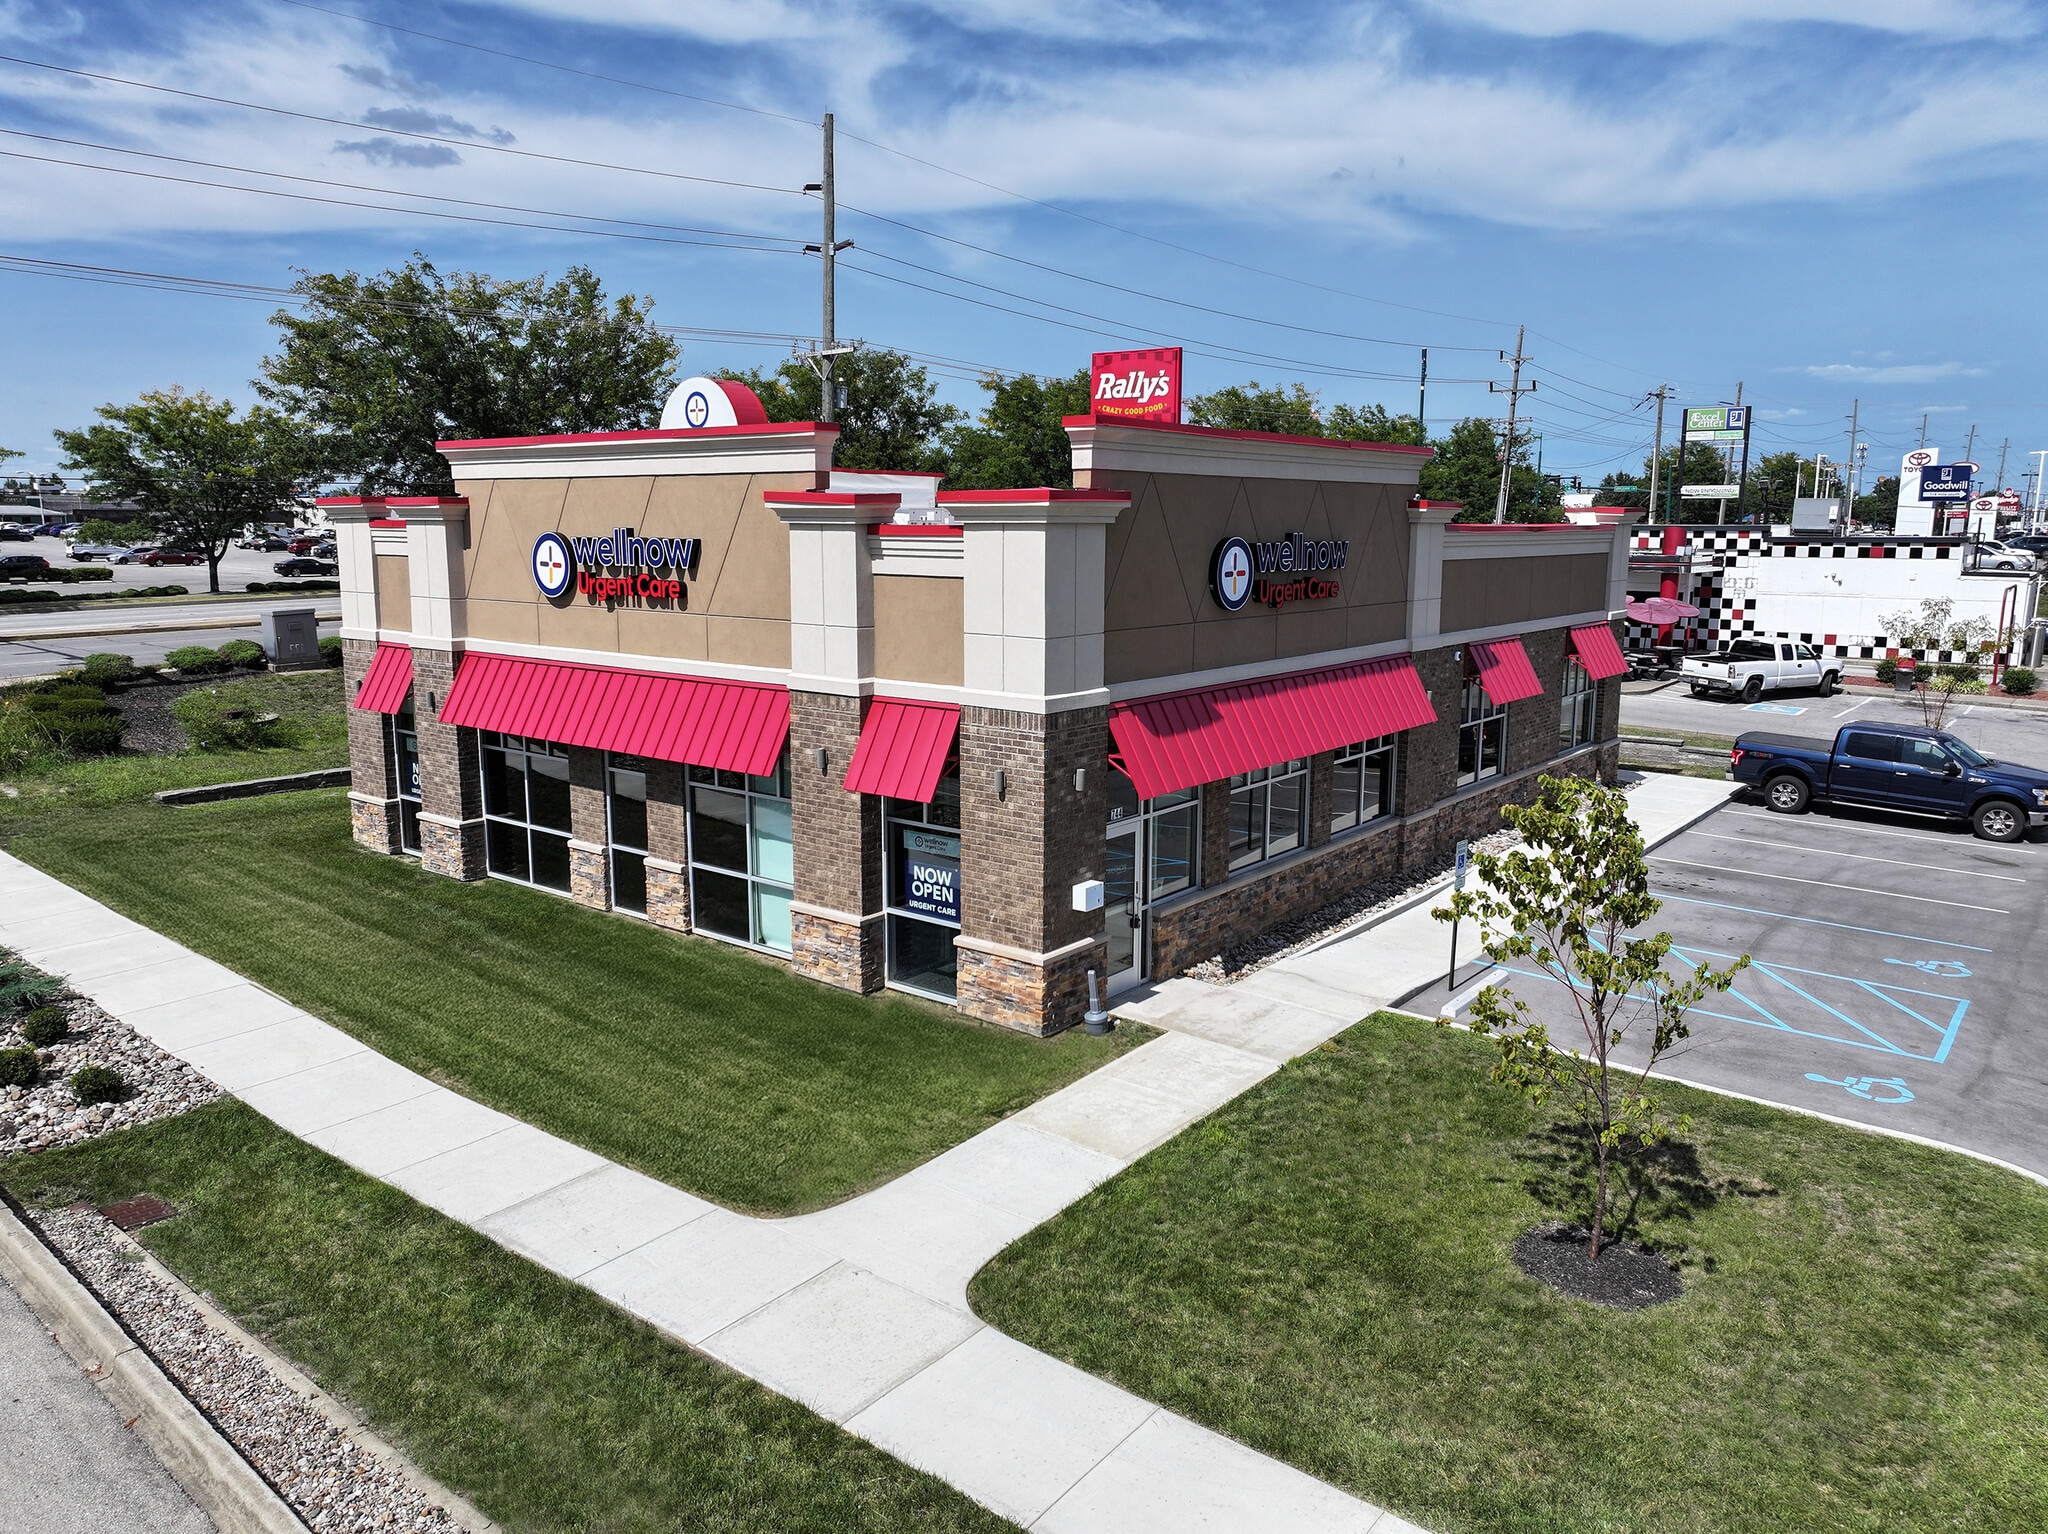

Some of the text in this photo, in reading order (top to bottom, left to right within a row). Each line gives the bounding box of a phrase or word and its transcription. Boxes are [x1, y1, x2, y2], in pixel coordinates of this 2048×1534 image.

[1094, 369, 1170, 403] Rally's
[1101, 403, 1163, 415] CRAZY GOOD FOOD
[1690, 411, 1720, 422] Excel
[1689, 419, 1724, 428] Center
[1923, 480, 1968, 490] Goodwill
[571, 527, 694, 569] wellnow
[1256, 532, 1350, 573] wellnow
[577, 571, 681, 601] Urgent Care
[1260, 576, 1340, 608] Urgent Care
[913, 865, 952, 887] NOW
[911, 880, 954, 903] OPEN
[909, 899, 957, 917] URGENT CARE
